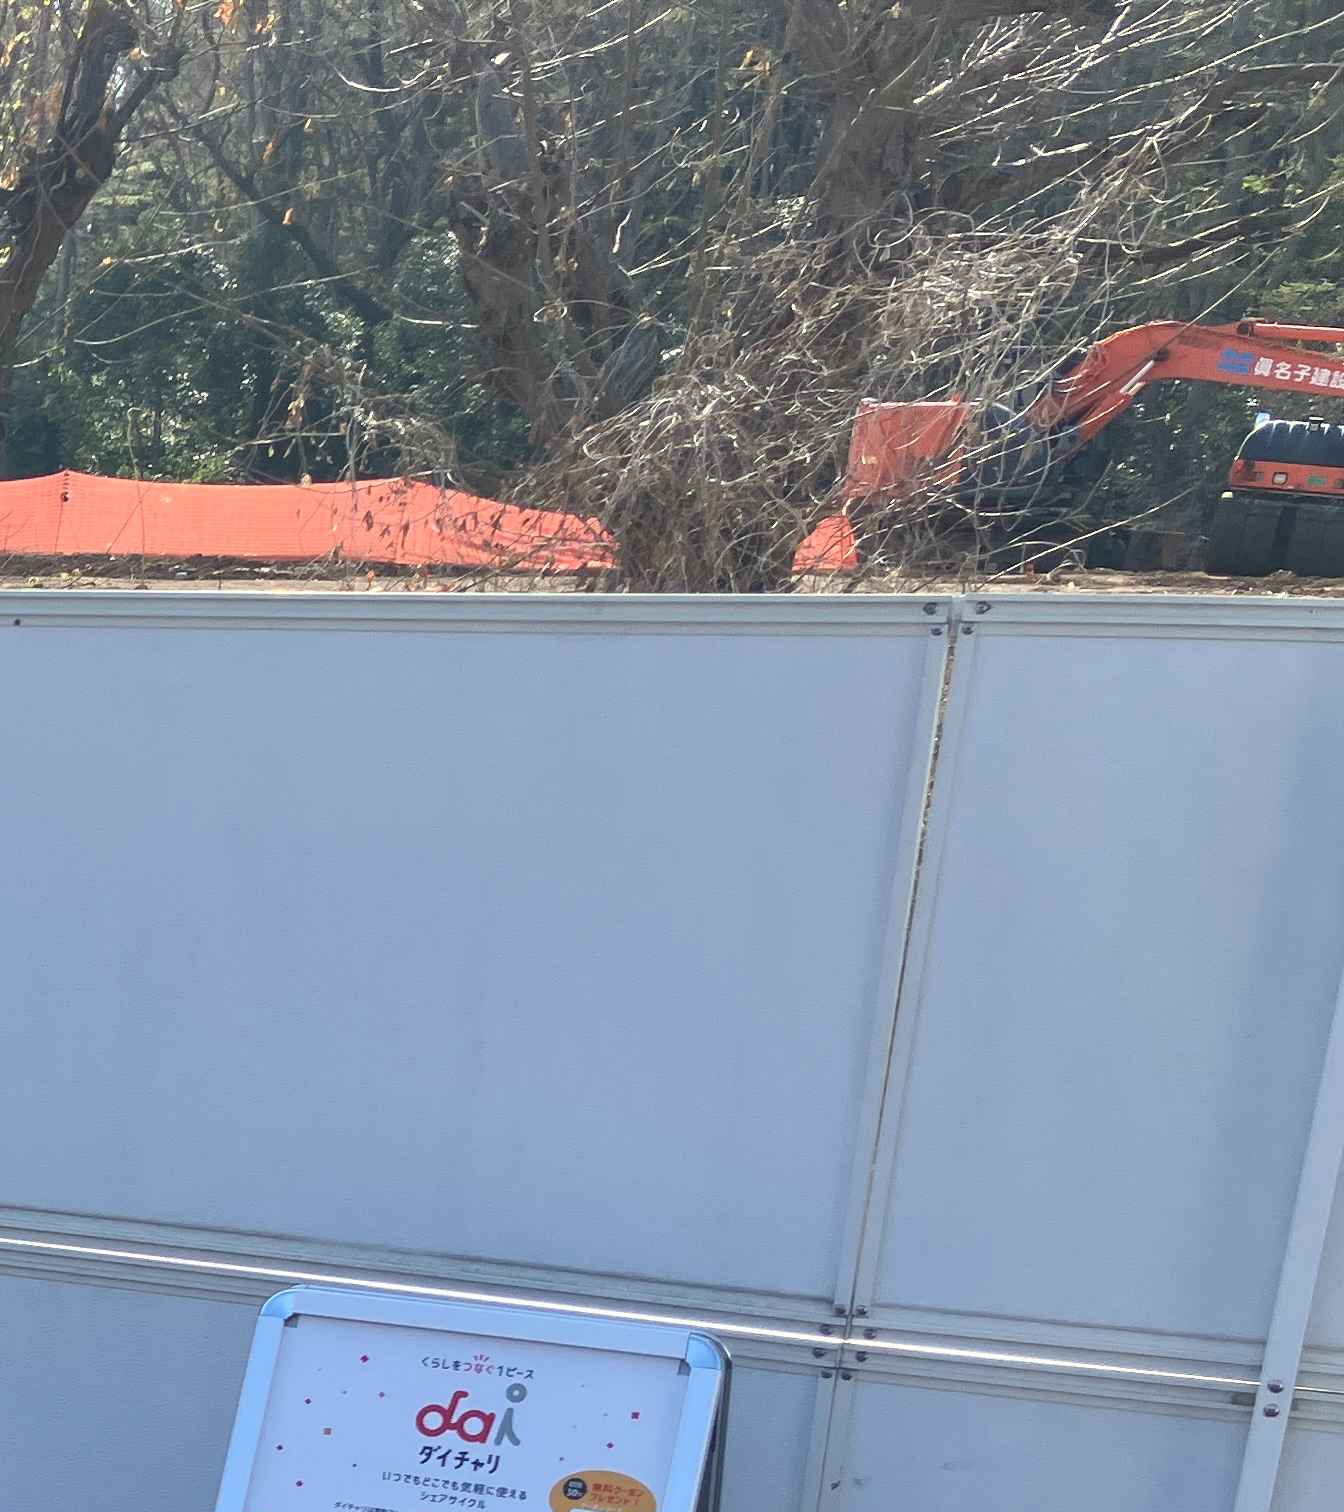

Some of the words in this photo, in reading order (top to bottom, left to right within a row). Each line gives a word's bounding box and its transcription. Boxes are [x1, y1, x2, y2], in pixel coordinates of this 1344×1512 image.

[416, 1383, 528, 1446] dai
[418, 1445, 500, 1474] ダイチャリ
[382, 1471, 527, 1501] いつでもどこでも気軽に使える
[420, 1490, 486, 1510] シェアサイクル
